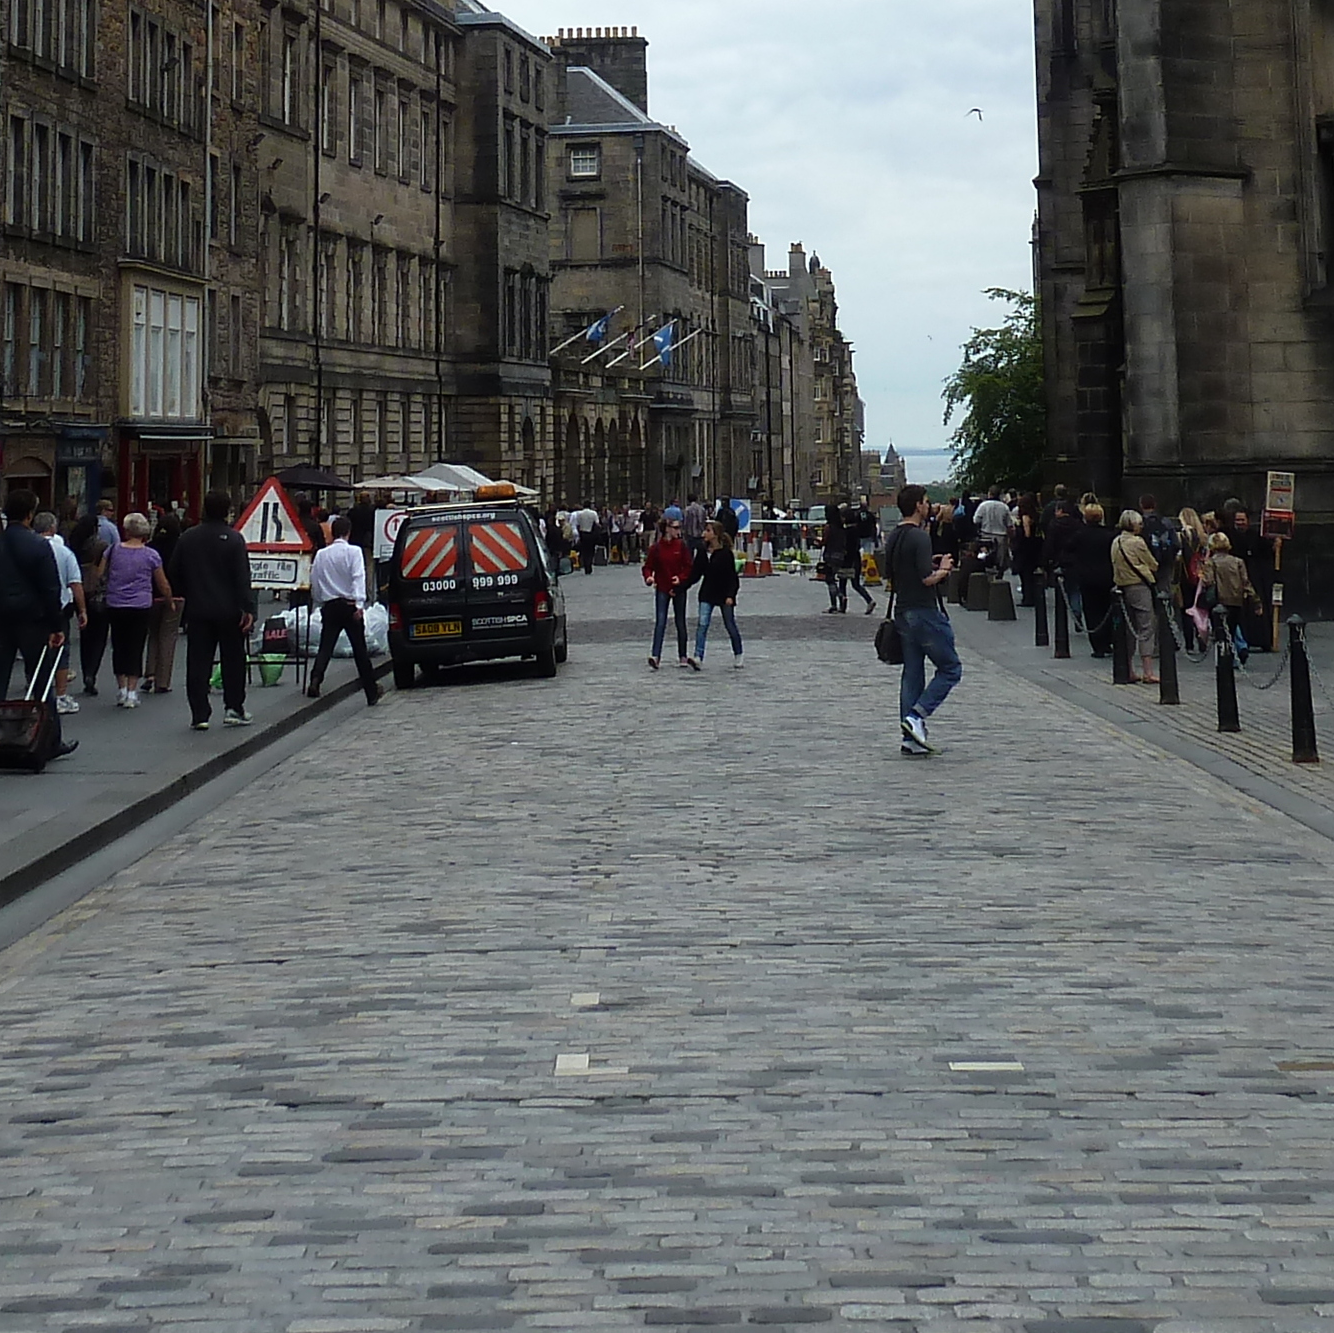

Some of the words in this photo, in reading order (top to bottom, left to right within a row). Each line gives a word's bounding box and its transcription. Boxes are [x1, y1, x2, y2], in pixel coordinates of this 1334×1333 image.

[422, 579, 456, 592] 03000
[472, 576, 493, 589] 999
[497, 574, 518, 586] 999
